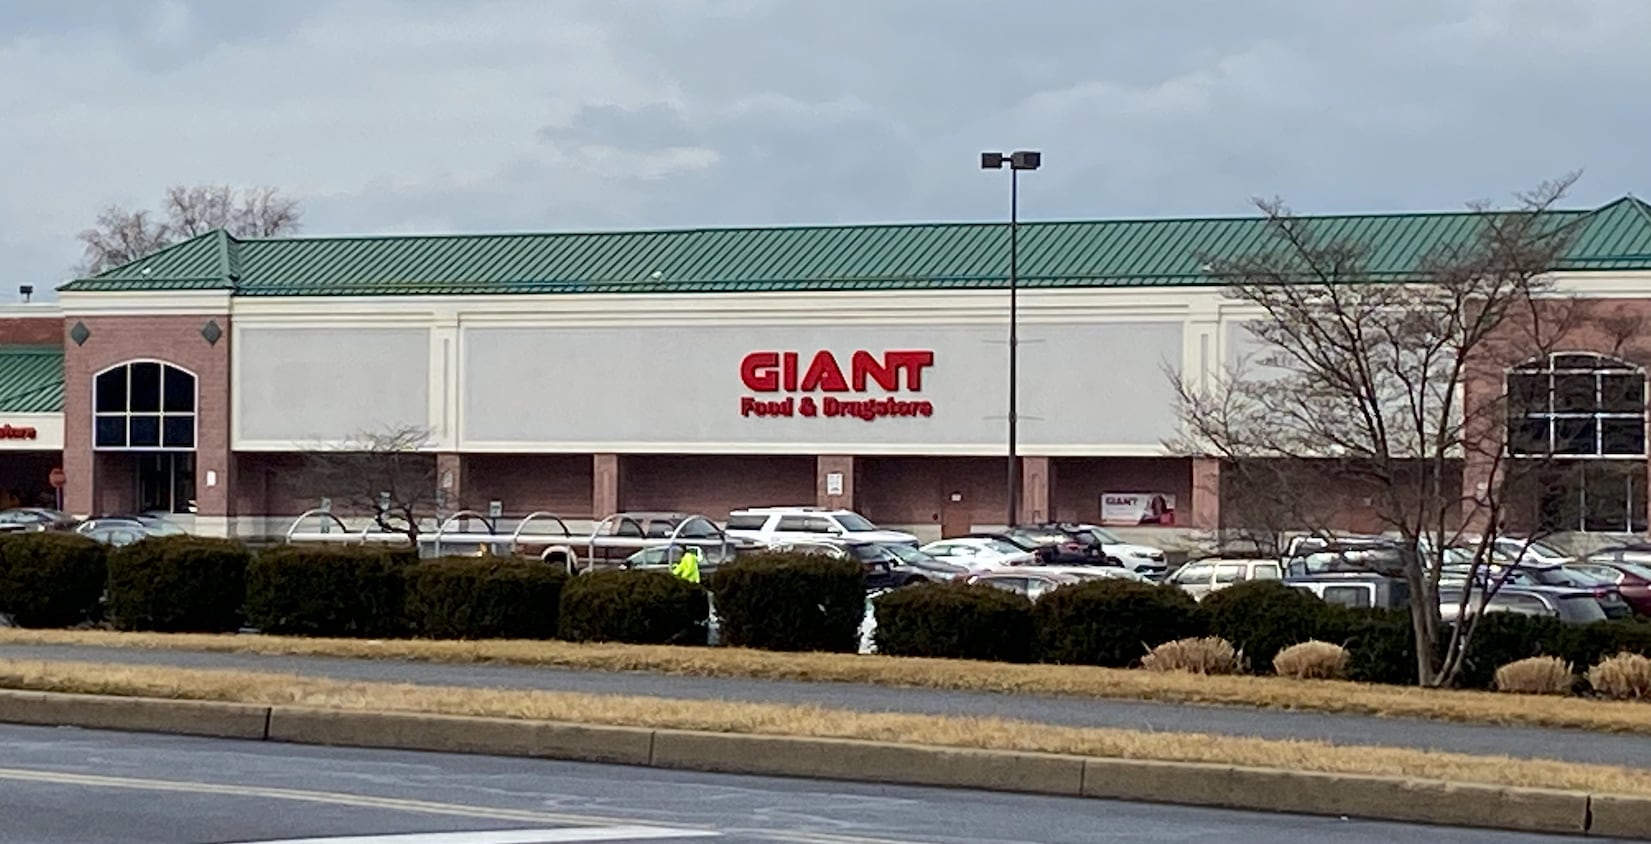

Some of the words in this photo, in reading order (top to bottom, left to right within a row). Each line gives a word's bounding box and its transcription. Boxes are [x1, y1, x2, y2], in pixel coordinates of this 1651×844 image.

[739, 349, 934, 392] GIANT
[740, 397, 794, 417] Food
[798, 396, 817, 417] &
[822, 396, 933, 421] Drugstore
[1105, 496, 1138, 506] GIANT
